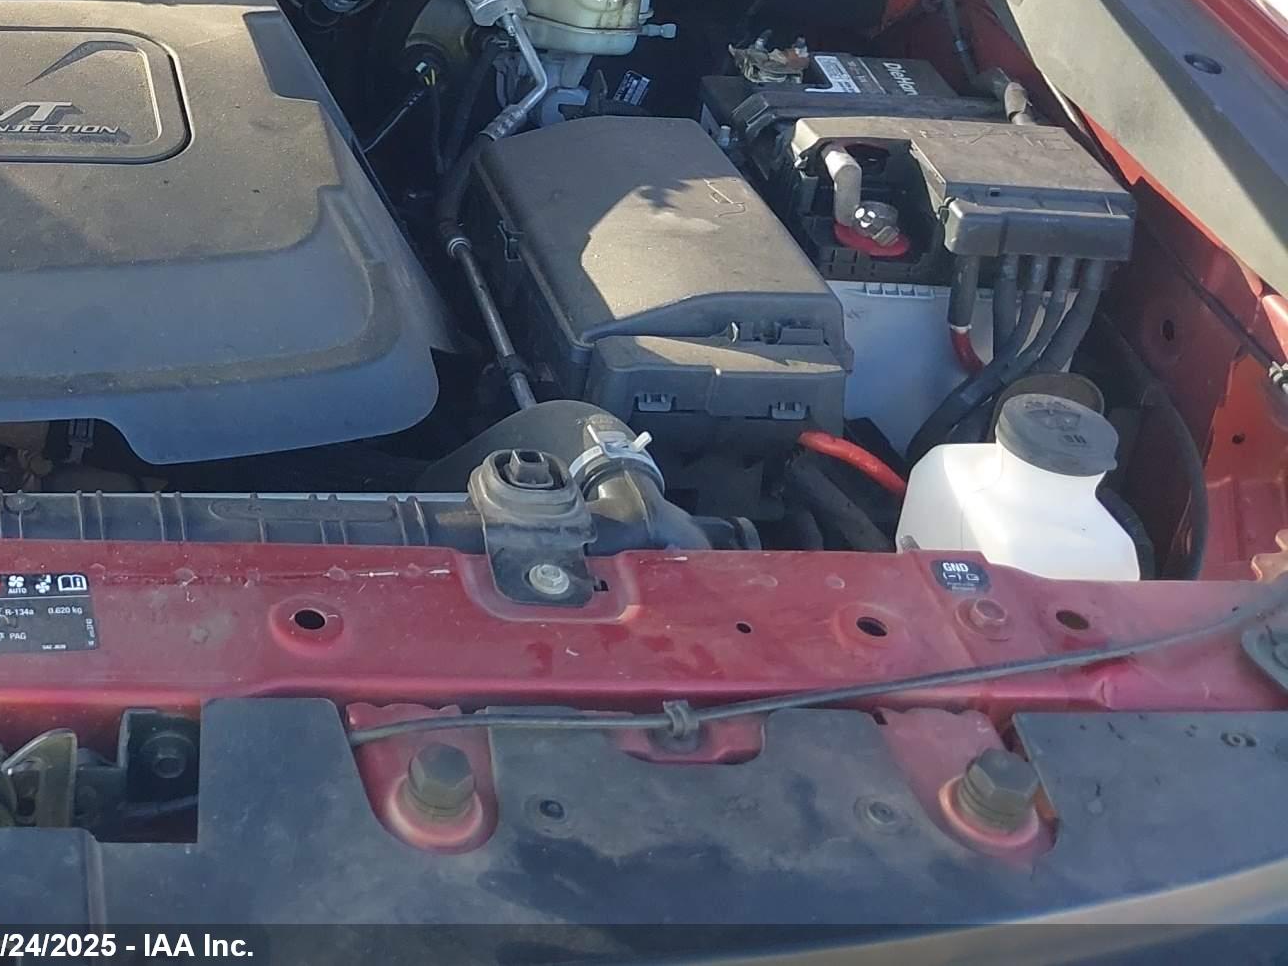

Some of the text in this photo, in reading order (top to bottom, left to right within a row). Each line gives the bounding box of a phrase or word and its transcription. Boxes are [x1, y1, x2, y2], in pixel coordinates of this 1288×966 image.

[882, 61, 920, 95] DieHar
[942, 562, 969, 572] GND
[4, 608, 35, 616] R-134a
[71, 606, 83, 615] kg
[9, 632, 27, 640] PAG
